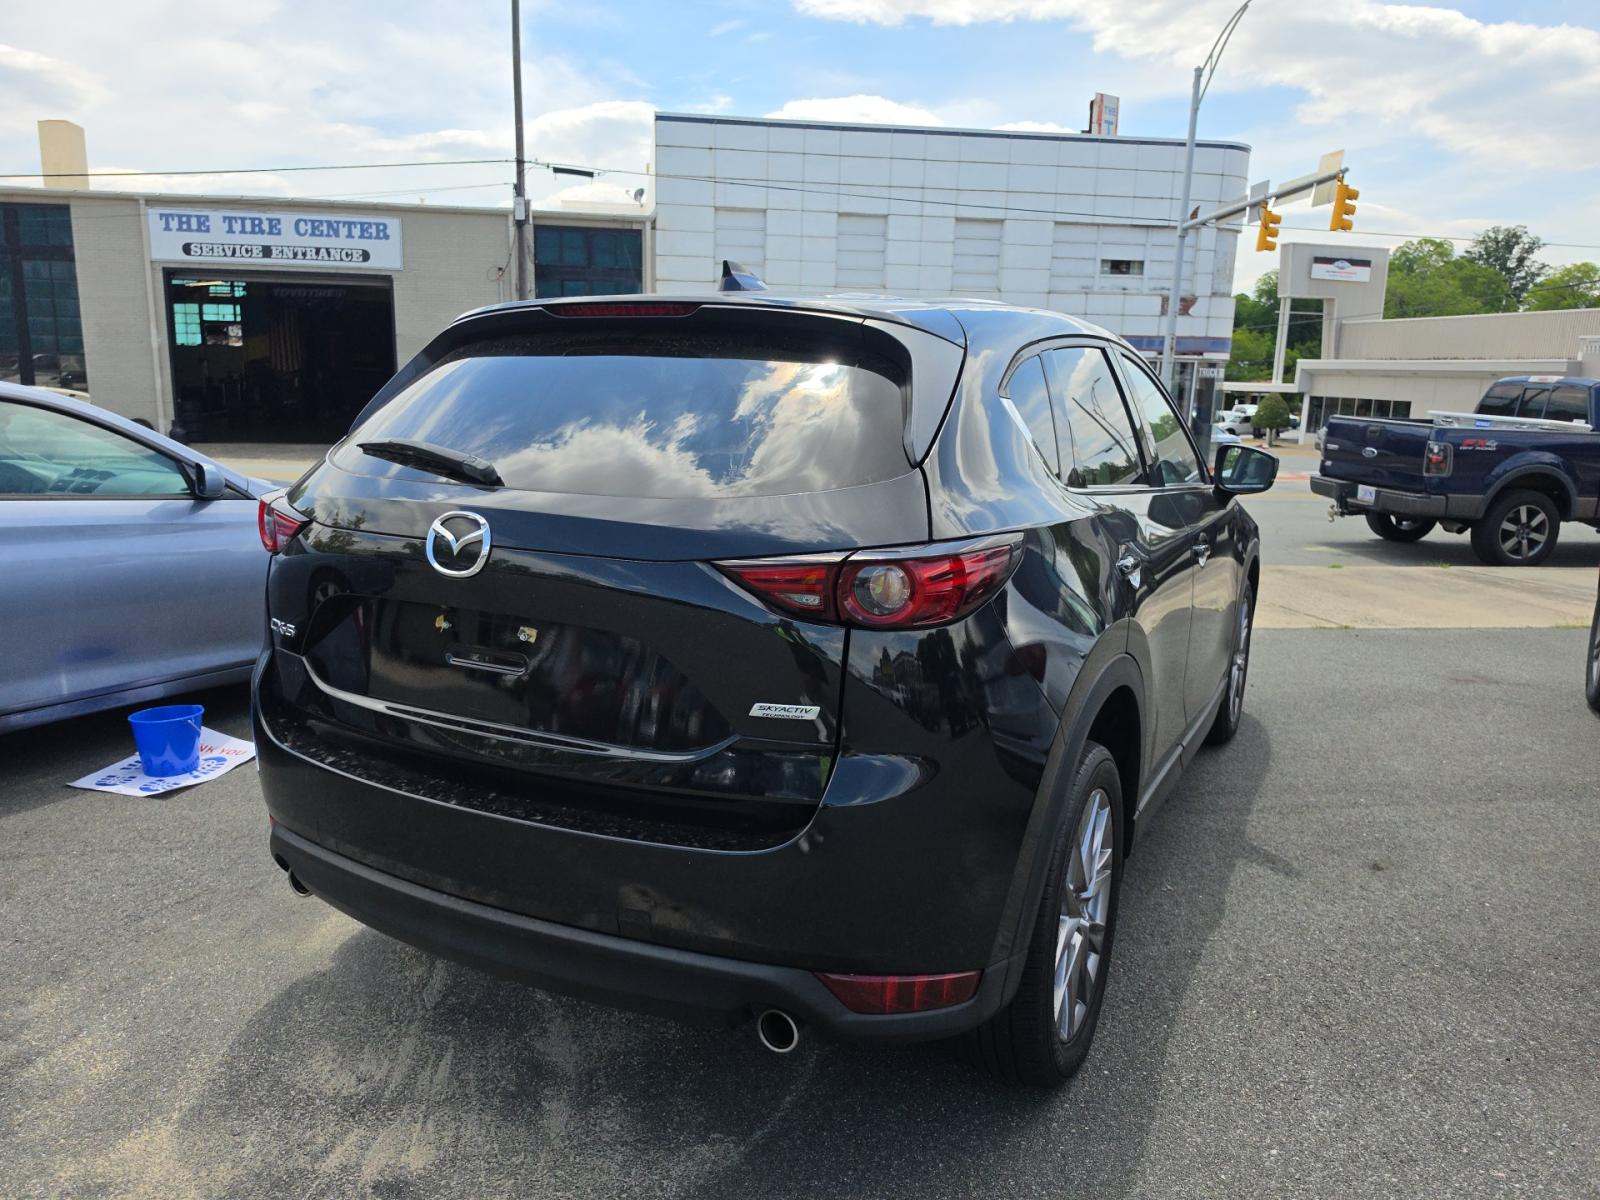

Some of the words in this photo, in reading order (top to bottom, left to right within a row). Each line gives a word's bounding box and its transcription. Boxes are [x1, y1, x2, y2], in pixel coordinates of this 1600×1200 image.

[159, 213, 210, 233] THE
[222, 215, 281, 236] TIRE
[294, 218, 390, 240] CENTER
[190, 242, 263, 258] SERVICE
[271, 245, 364, 262] ENTRANCE
[757, 705, 814, 714] SKYACTIV
